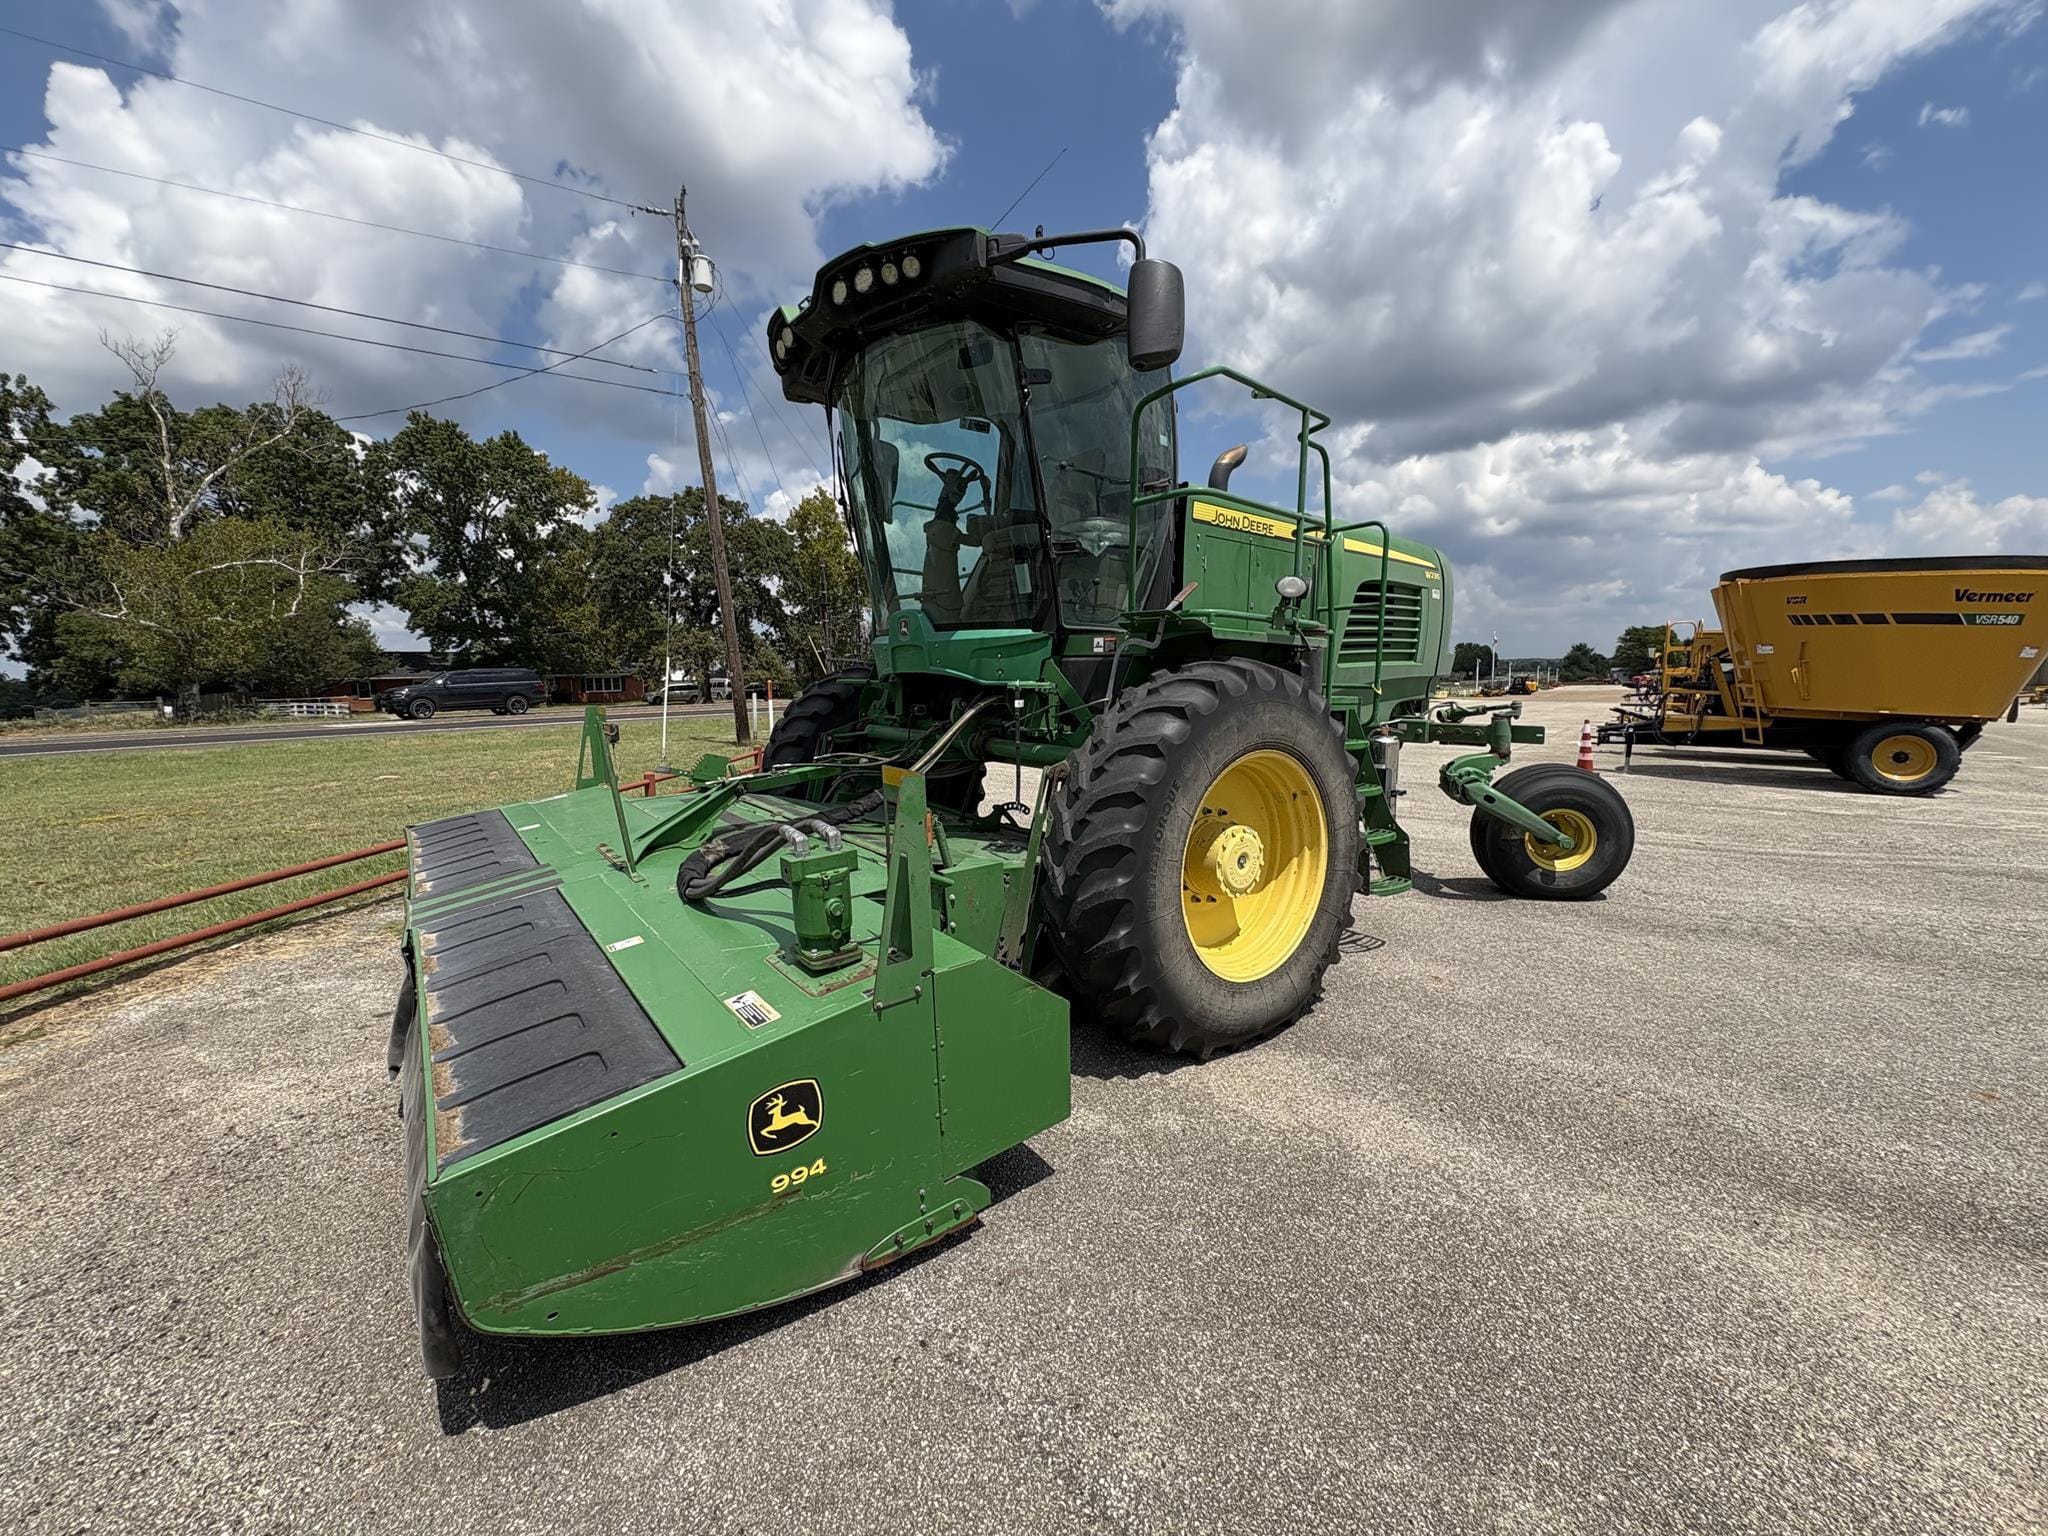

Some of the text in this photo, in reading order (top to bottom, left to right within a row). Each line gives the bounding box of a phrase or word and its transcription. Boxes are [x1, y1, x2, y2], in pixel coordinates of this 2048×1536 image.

[1212, 510, 1274, 535] JOHN DEERE
[1954, 588, 2035, 603] Vermeer
[1975, 615, 2019, 625] VSR540
[771, 1158, 827, 1193] 994
